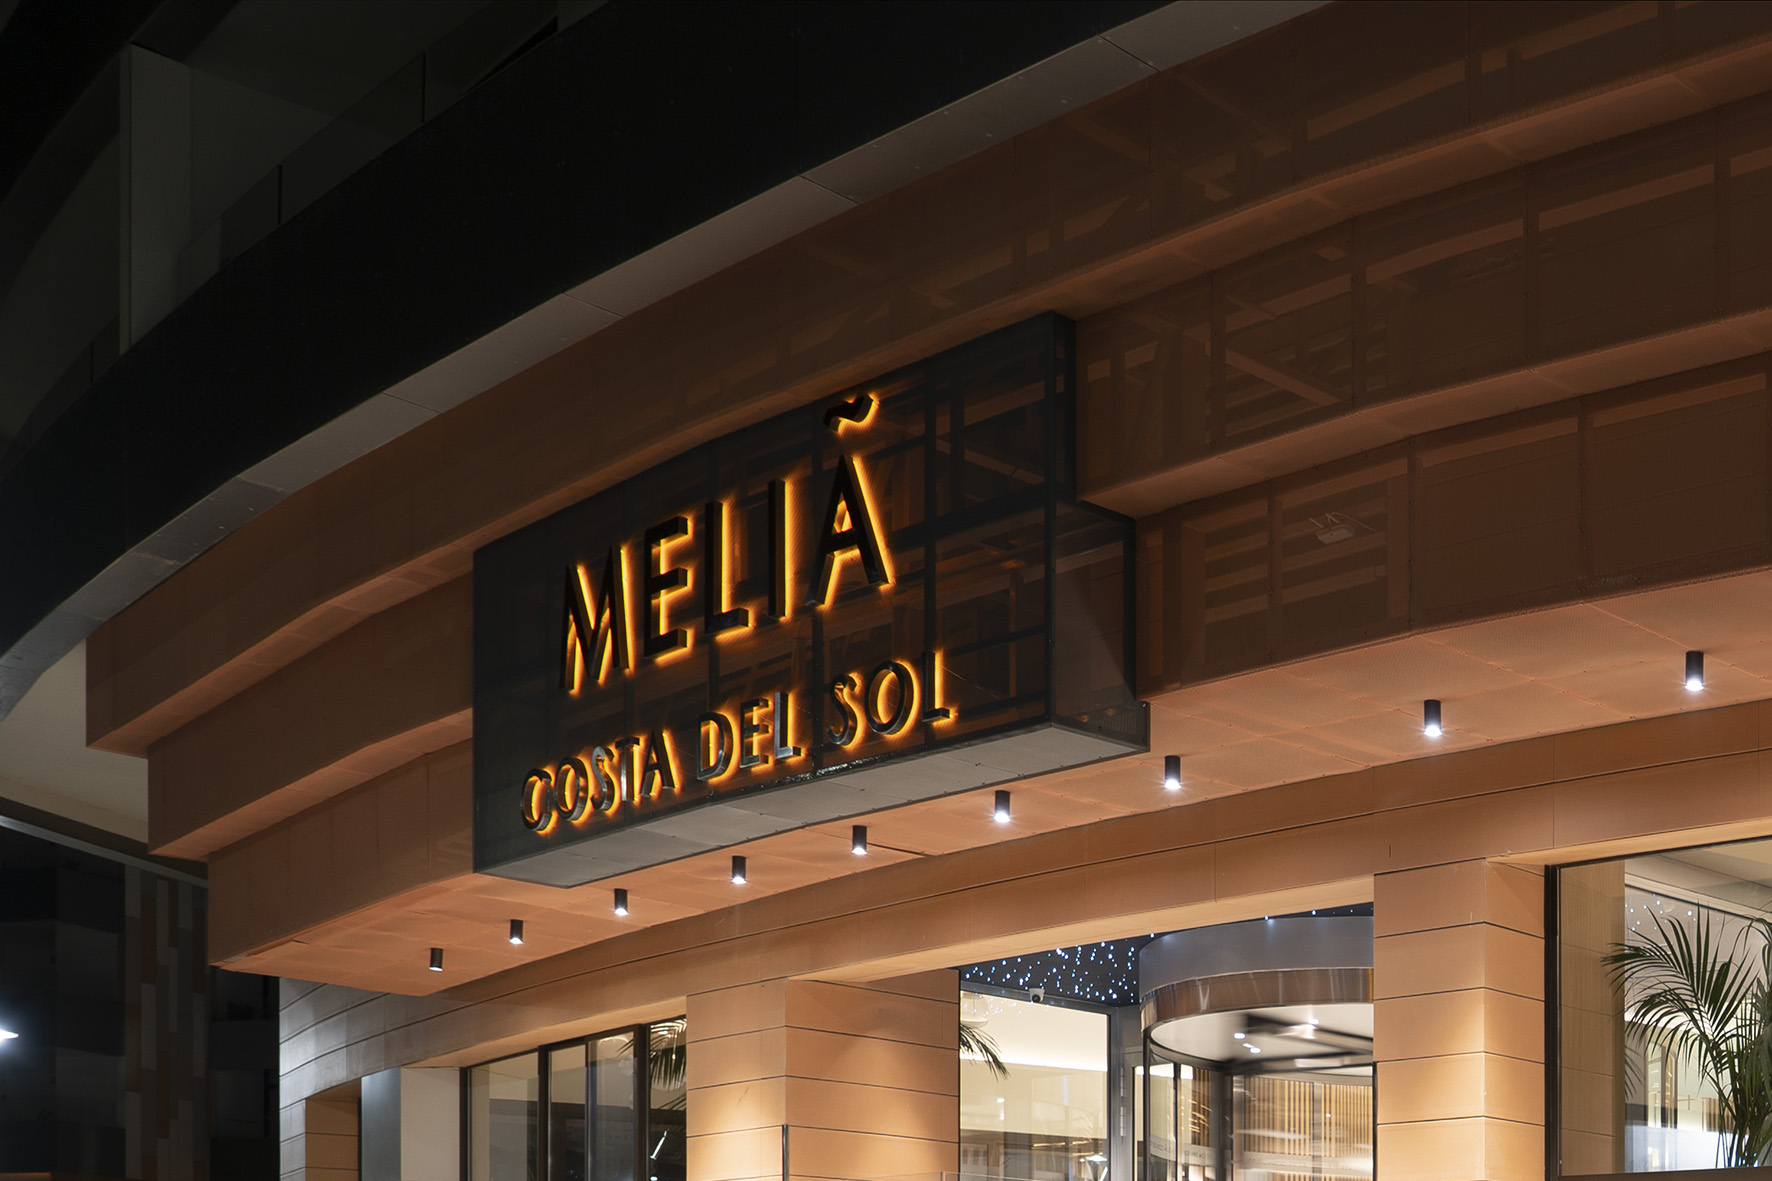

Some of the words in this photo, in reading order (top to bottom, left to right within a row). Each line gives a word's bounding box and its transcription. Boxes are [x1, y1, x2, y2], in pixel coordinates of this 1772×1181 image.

[520, 728, 684, 834] COSTA
[697, 691, 803, 783] DEL
[827, 648, 958, 748] SOL
